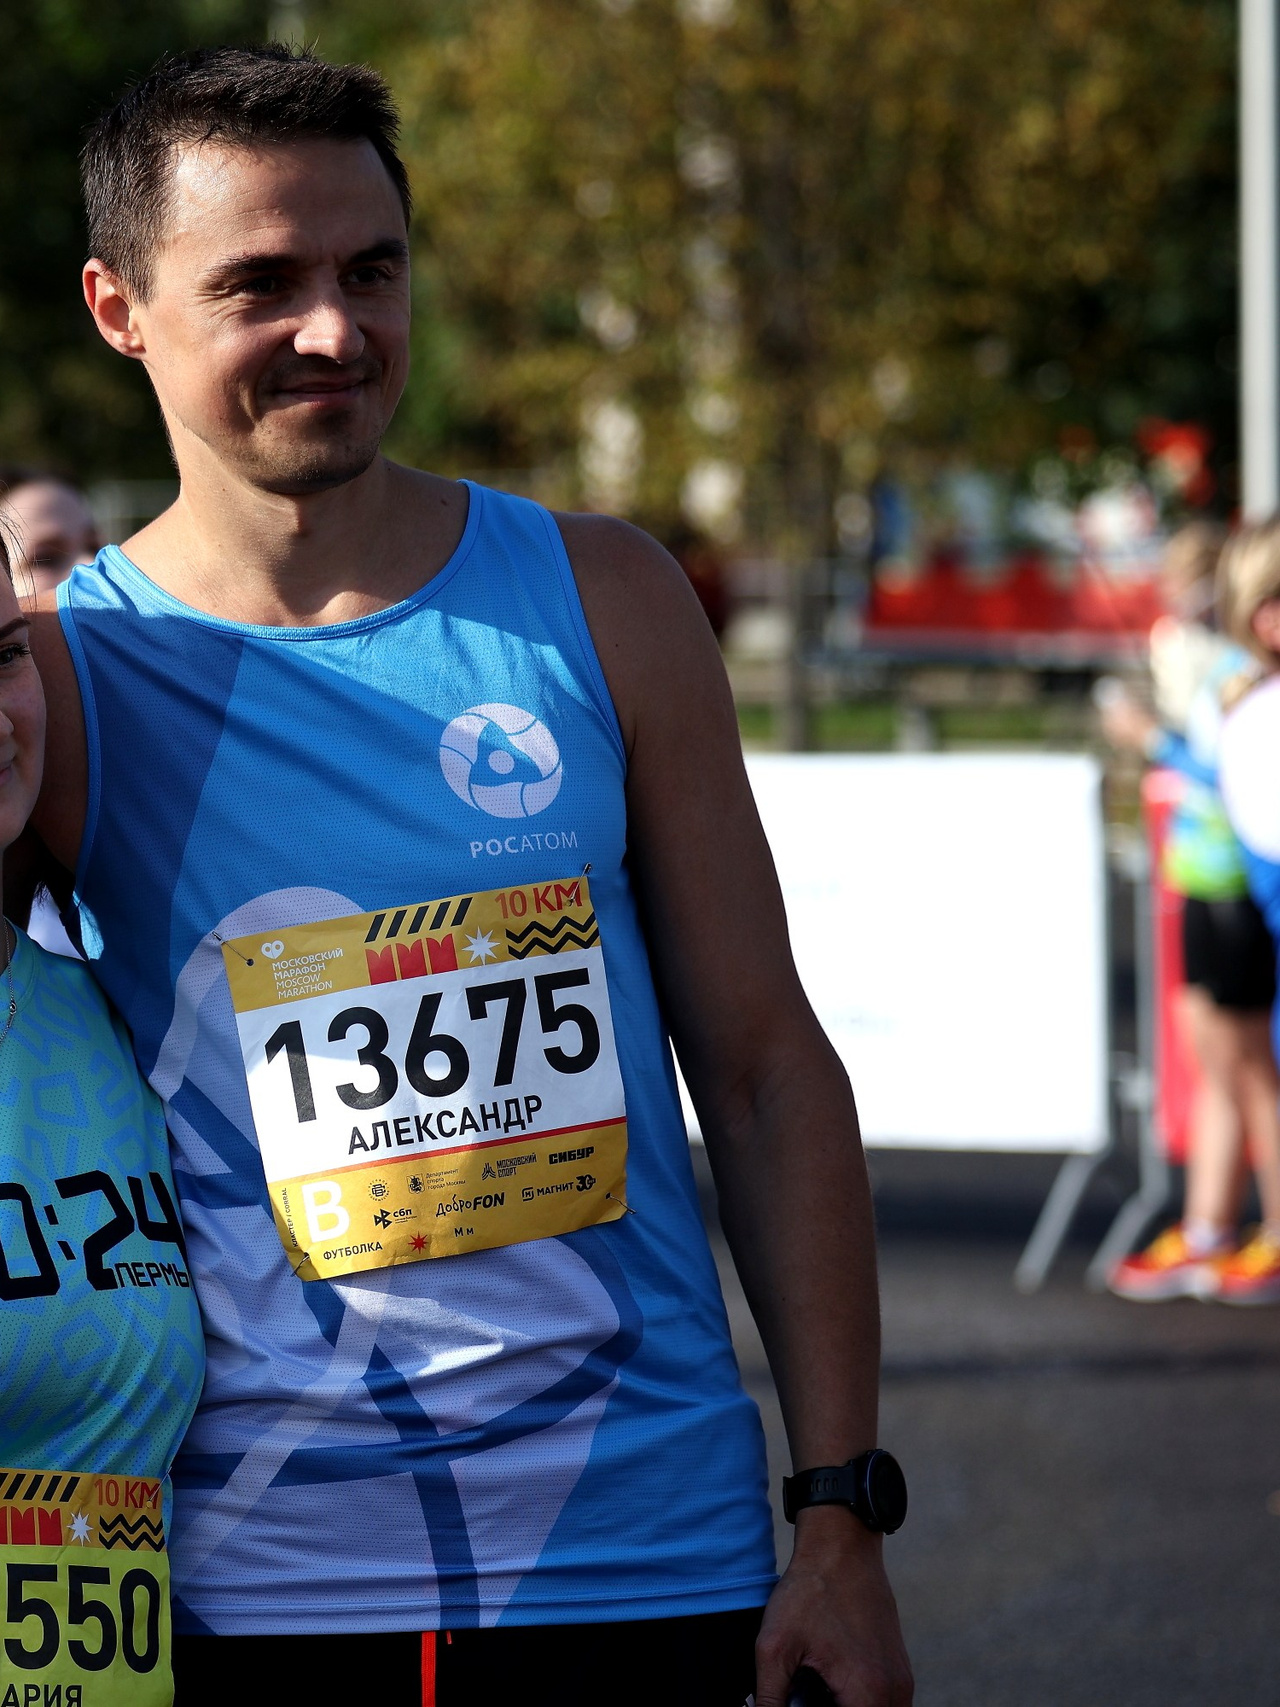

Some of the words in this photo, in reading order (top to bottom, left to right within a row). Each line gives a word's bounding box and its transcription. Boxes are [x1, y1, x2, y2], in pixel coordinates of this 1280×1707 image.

[470, 831, 578, 858] РОСАТОМ
[494, 890, 528, 919] 10
[272, 948, 344, 971] МОСКОВСКИЙ
[274, 962, 326, 980] МАРАФОН
[276, 973, 321, 990] MOSCOW
[278, 981, 333, 999] MARATHON
[265, 968, 601, 1124] 13675
[348, 1095, 543, 1155] АЛЕКСАНДР
[496, 1152, 537, 1169] МОСКОВСКИЙ
[548, 1146, 595, 1165] СИБУР
[498, 1166, 518, 1178] СПОРТ
[536, 1181, 574, 1197] МАГНИТ
[287, 1218, 298, 1247] КЛАСТЕР
[323, 1241, 383, 1261] ФУТБОЛКА
[114, 1262, 190, 1288] ПЕРМЬ
[94, 1478, 120, 1507] 10
